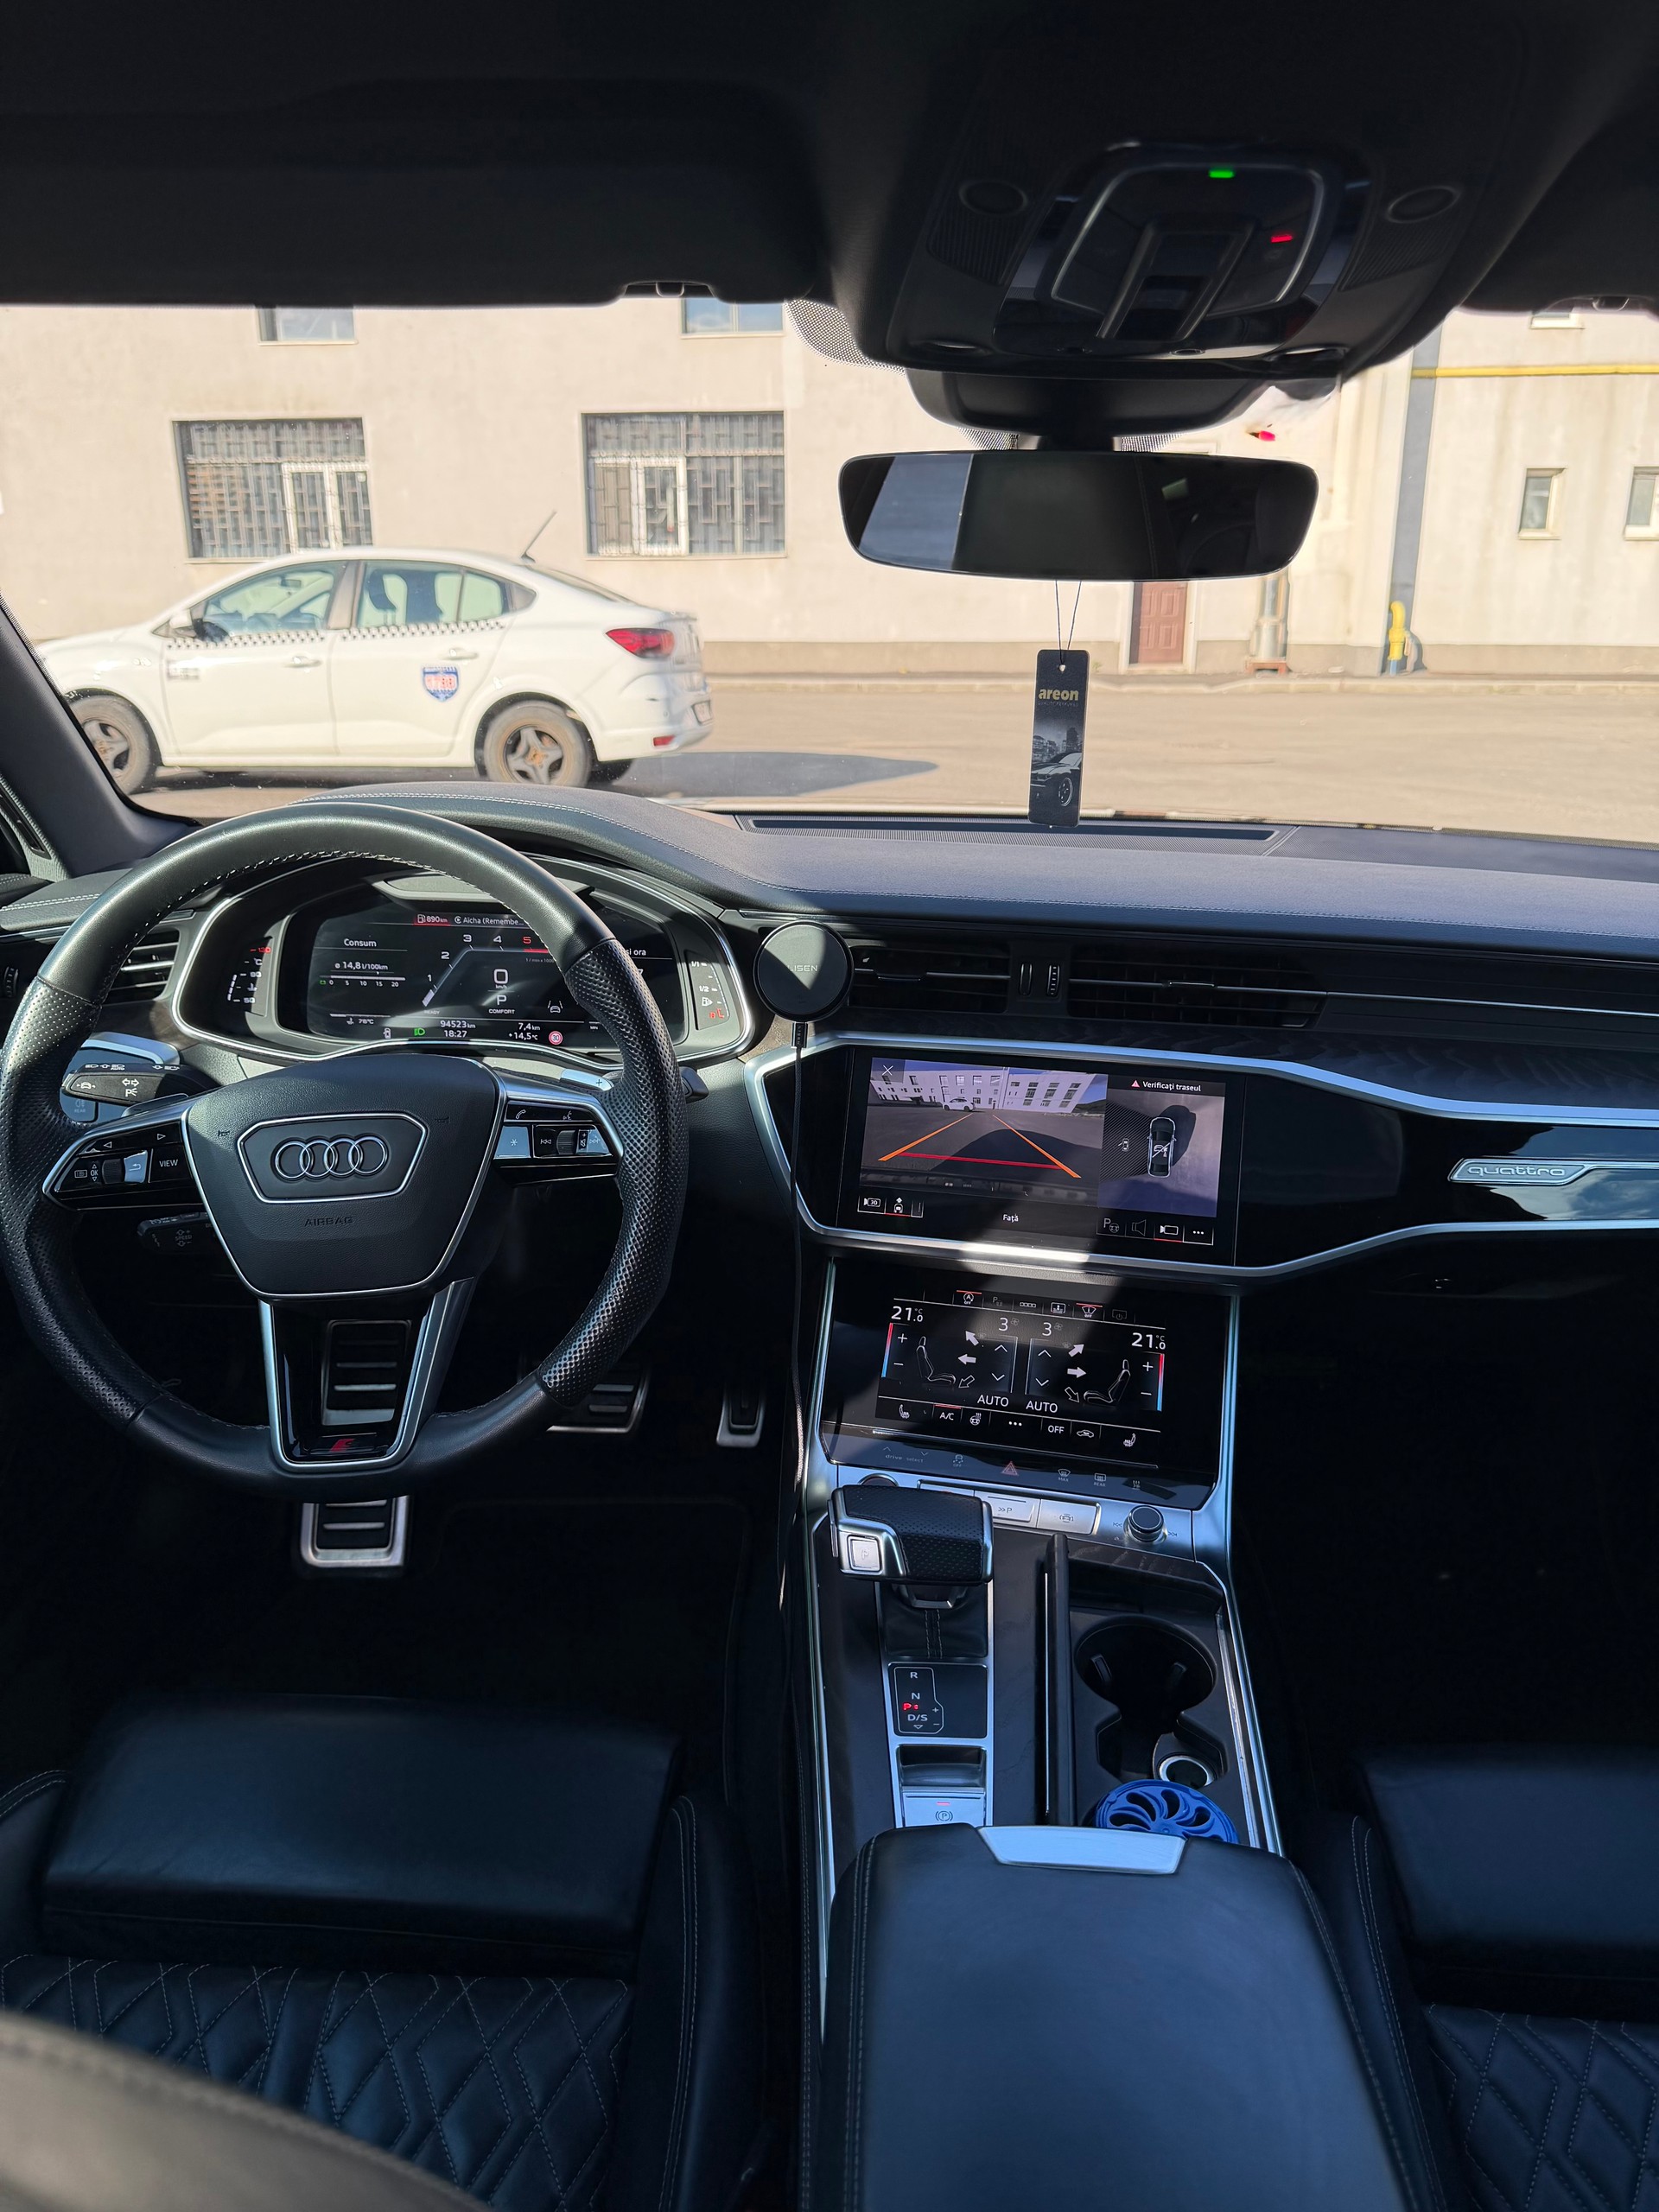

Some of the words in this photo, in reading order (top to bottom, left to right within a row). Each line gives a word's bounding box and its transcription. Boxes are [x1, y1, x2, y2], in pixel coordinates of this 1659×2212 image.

[1038, 689, 1079, 701] areon
[343, 938, 378, 947] Consum
[463, 934, 473, 943] 3
[493, 935, 502, 944] 4
[522, 936, 532, 944] 5
[441, 951, 450, 960] 2
[493, 969, 509, 985] 0
[496, 995, 507, 1006] P
[443, 1029, 467, 1038] 18:27
[1175, 1084, 1201, 1092] traseul
[159, 1159, 179, 1167] VIEW
[1466, 1166, 1566, 1177] quattro
[304, 1217, 353, 1227] AIRBAG
[998, 1317, 1009, 1332] 3
[1041, 1322, 1052, 1337] 3
[977, 1394, 1009, 1407] AUTO
[1026, 1400, 1058, 1414] AUTO
[939, 1412, 955, 1421] A/C
[1047, 1425, 1065, 1433] OFF
[907, 1713, 928, 1722] D/S
